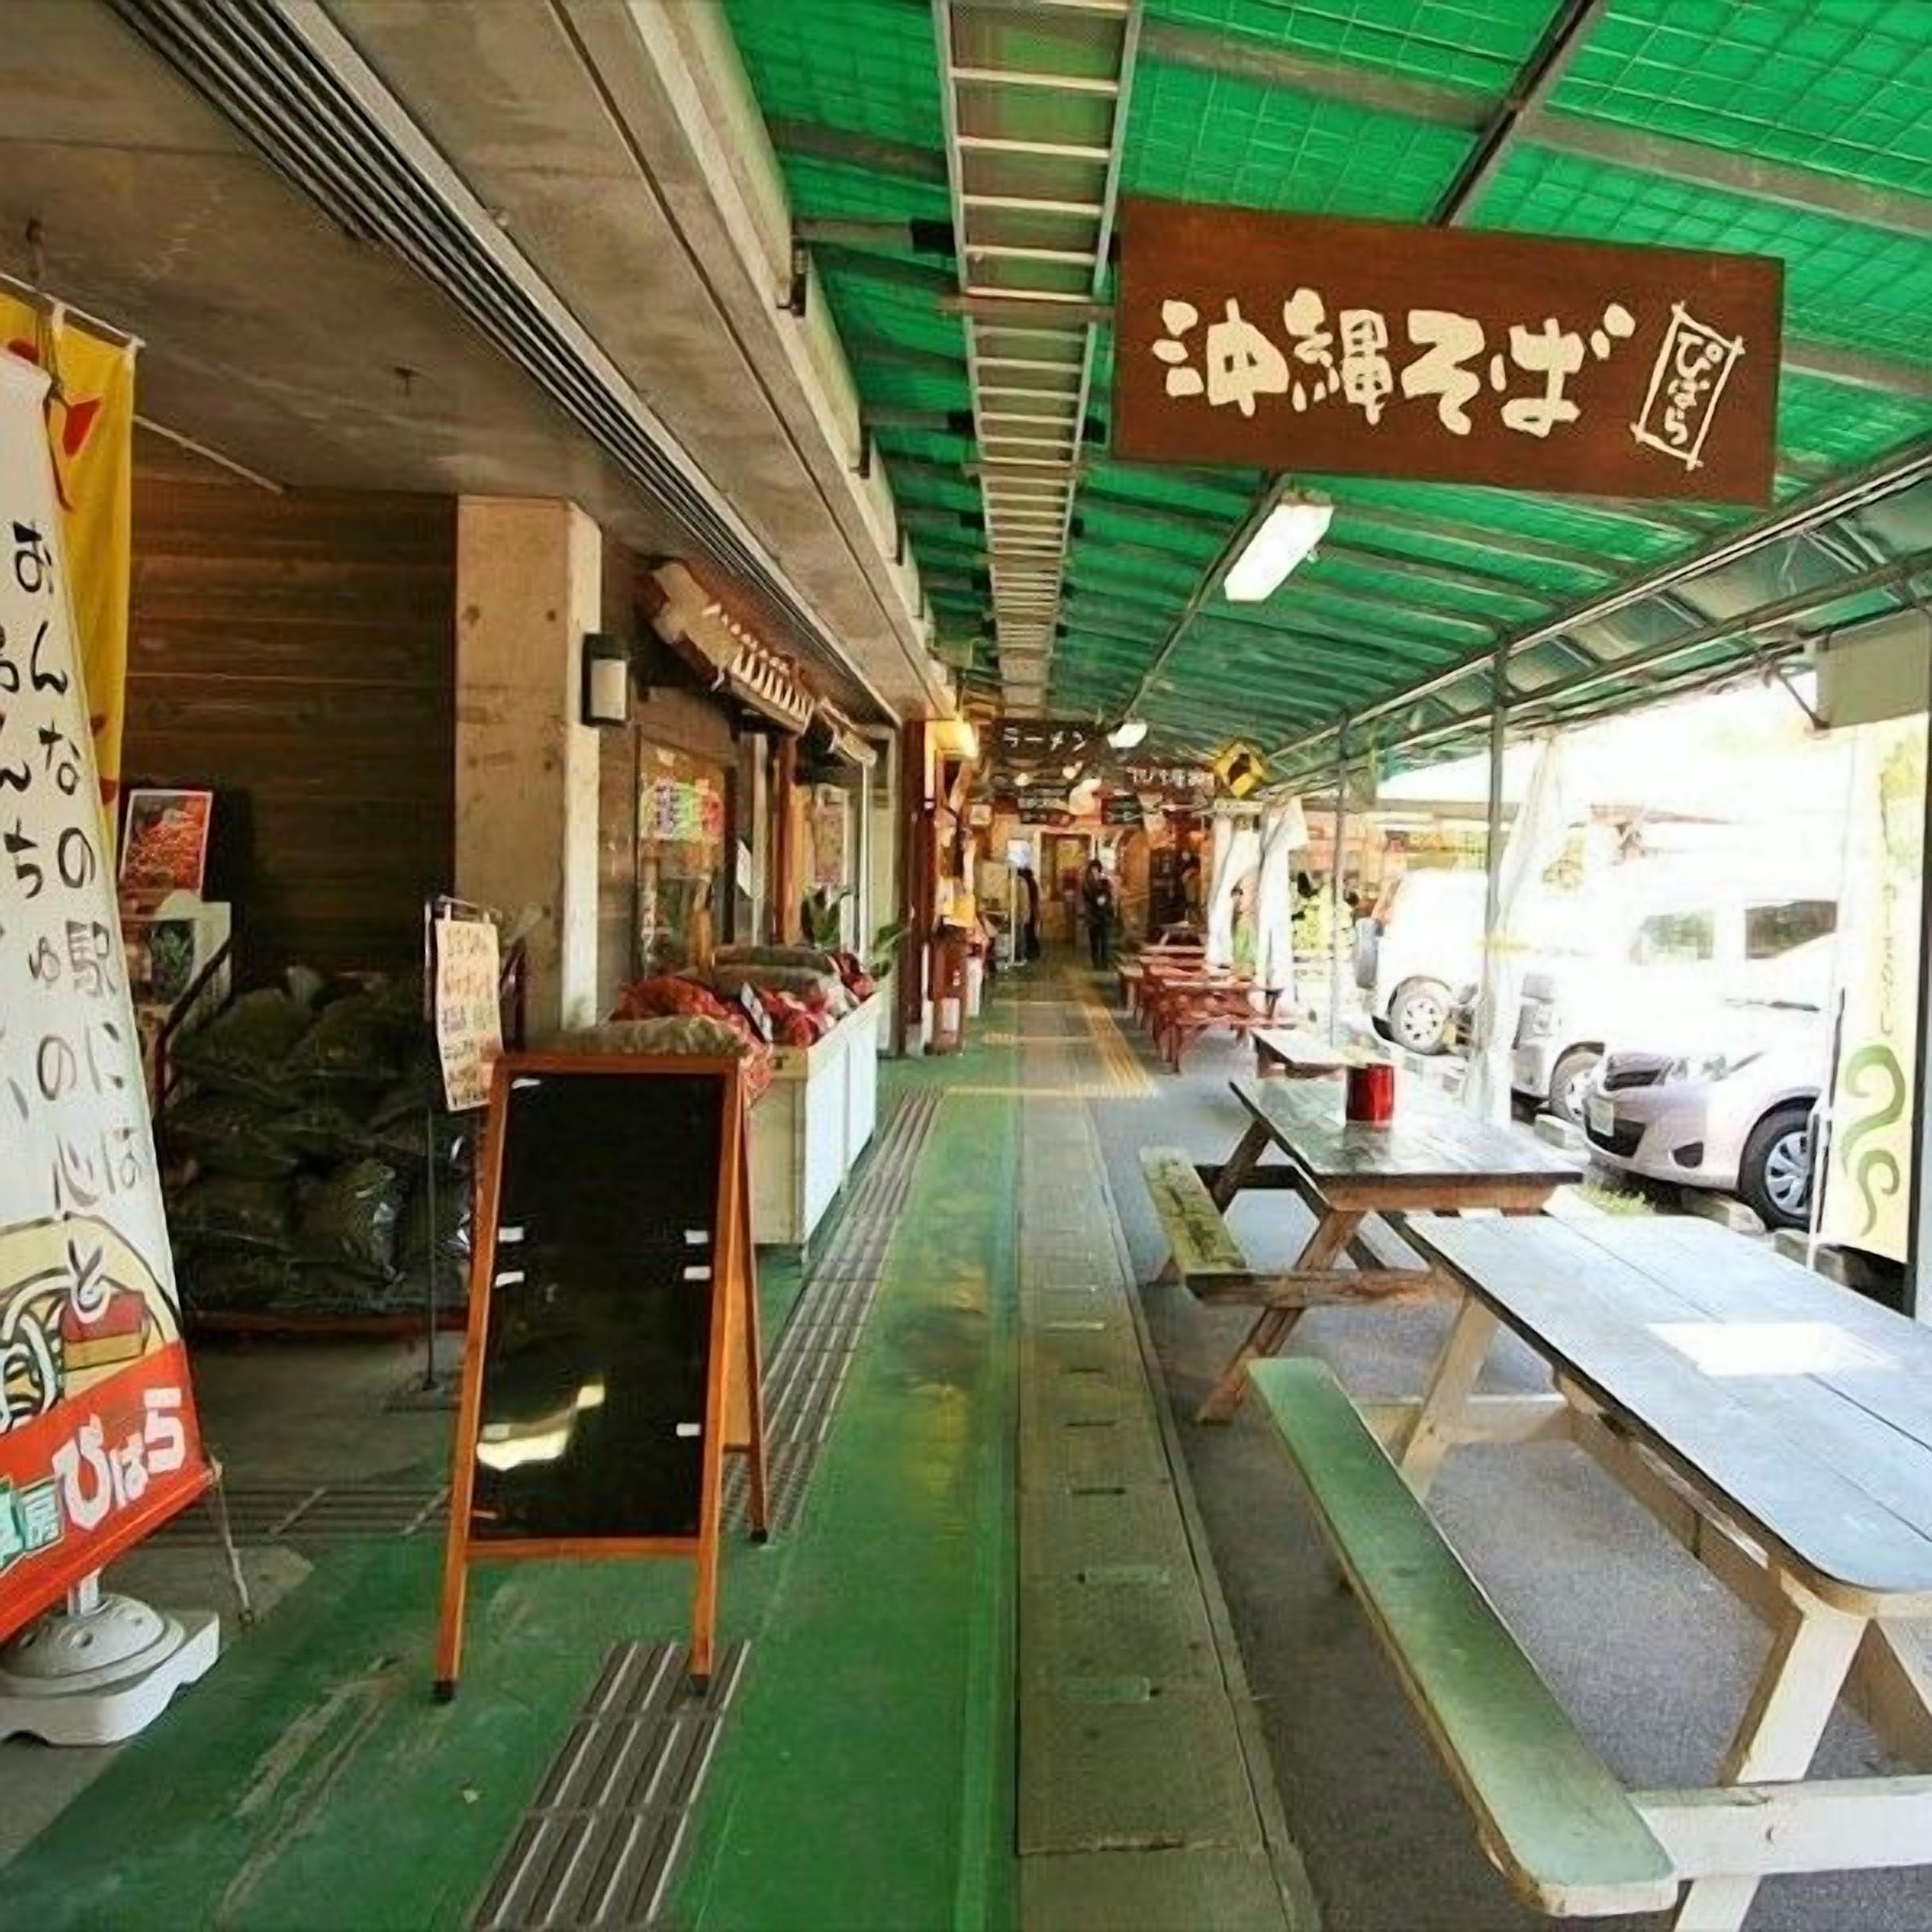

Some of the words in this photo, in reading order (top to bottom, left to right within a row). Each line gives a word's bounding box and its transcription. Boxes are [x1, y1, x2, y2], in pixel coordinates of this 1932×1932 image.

[1153, 288, 1635, 436] 沖縄そば
[1004, 727, 1087, 753] ラーメン
[12, 520, 150, 1195] おんなの駅には
